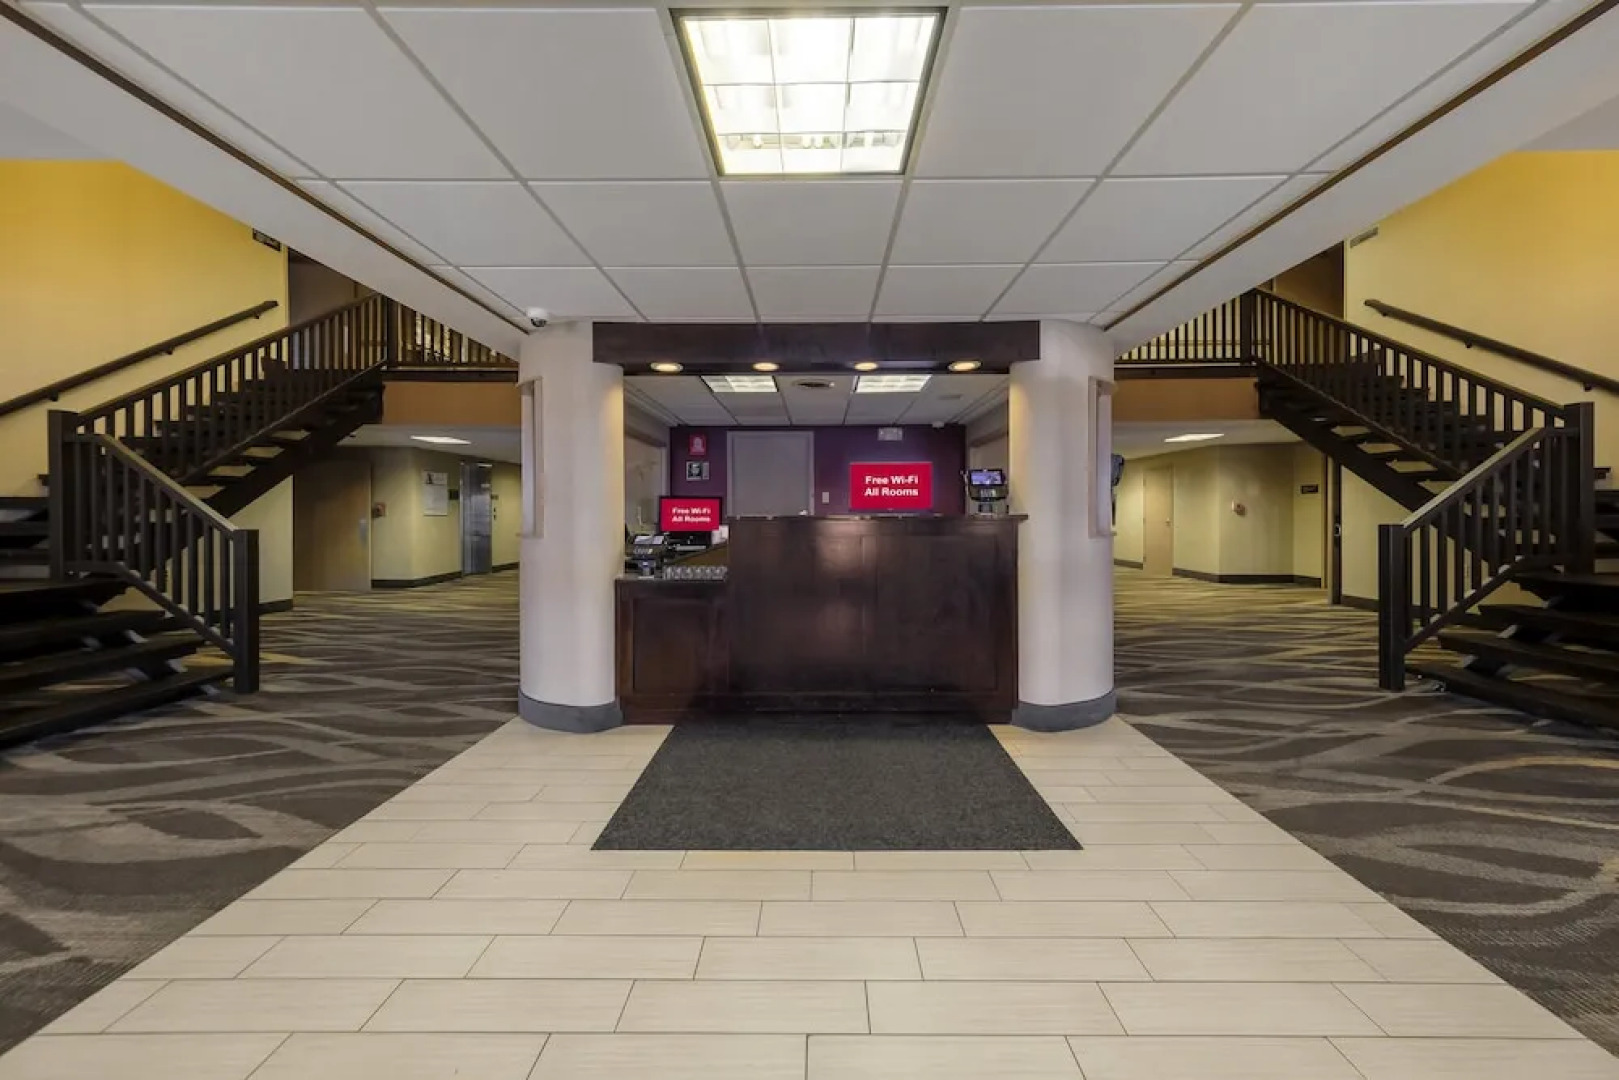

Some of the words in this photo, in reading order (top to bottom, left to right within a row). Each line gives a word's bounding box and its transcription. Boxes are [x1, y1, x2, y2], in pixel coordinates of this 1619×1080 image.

[865, 475, 889, 485] Free
[890, 475, 918, 485] Wi-Fi
[864, 487, 880, 496] All
[881, 487, 918, 496] Rooms
[672, 507, 690, 515] Free
[690, 507, 711, 515] Wi-Fi
[672, 515, 684, 523] All
[684, 515, 711, 523] Rooms
